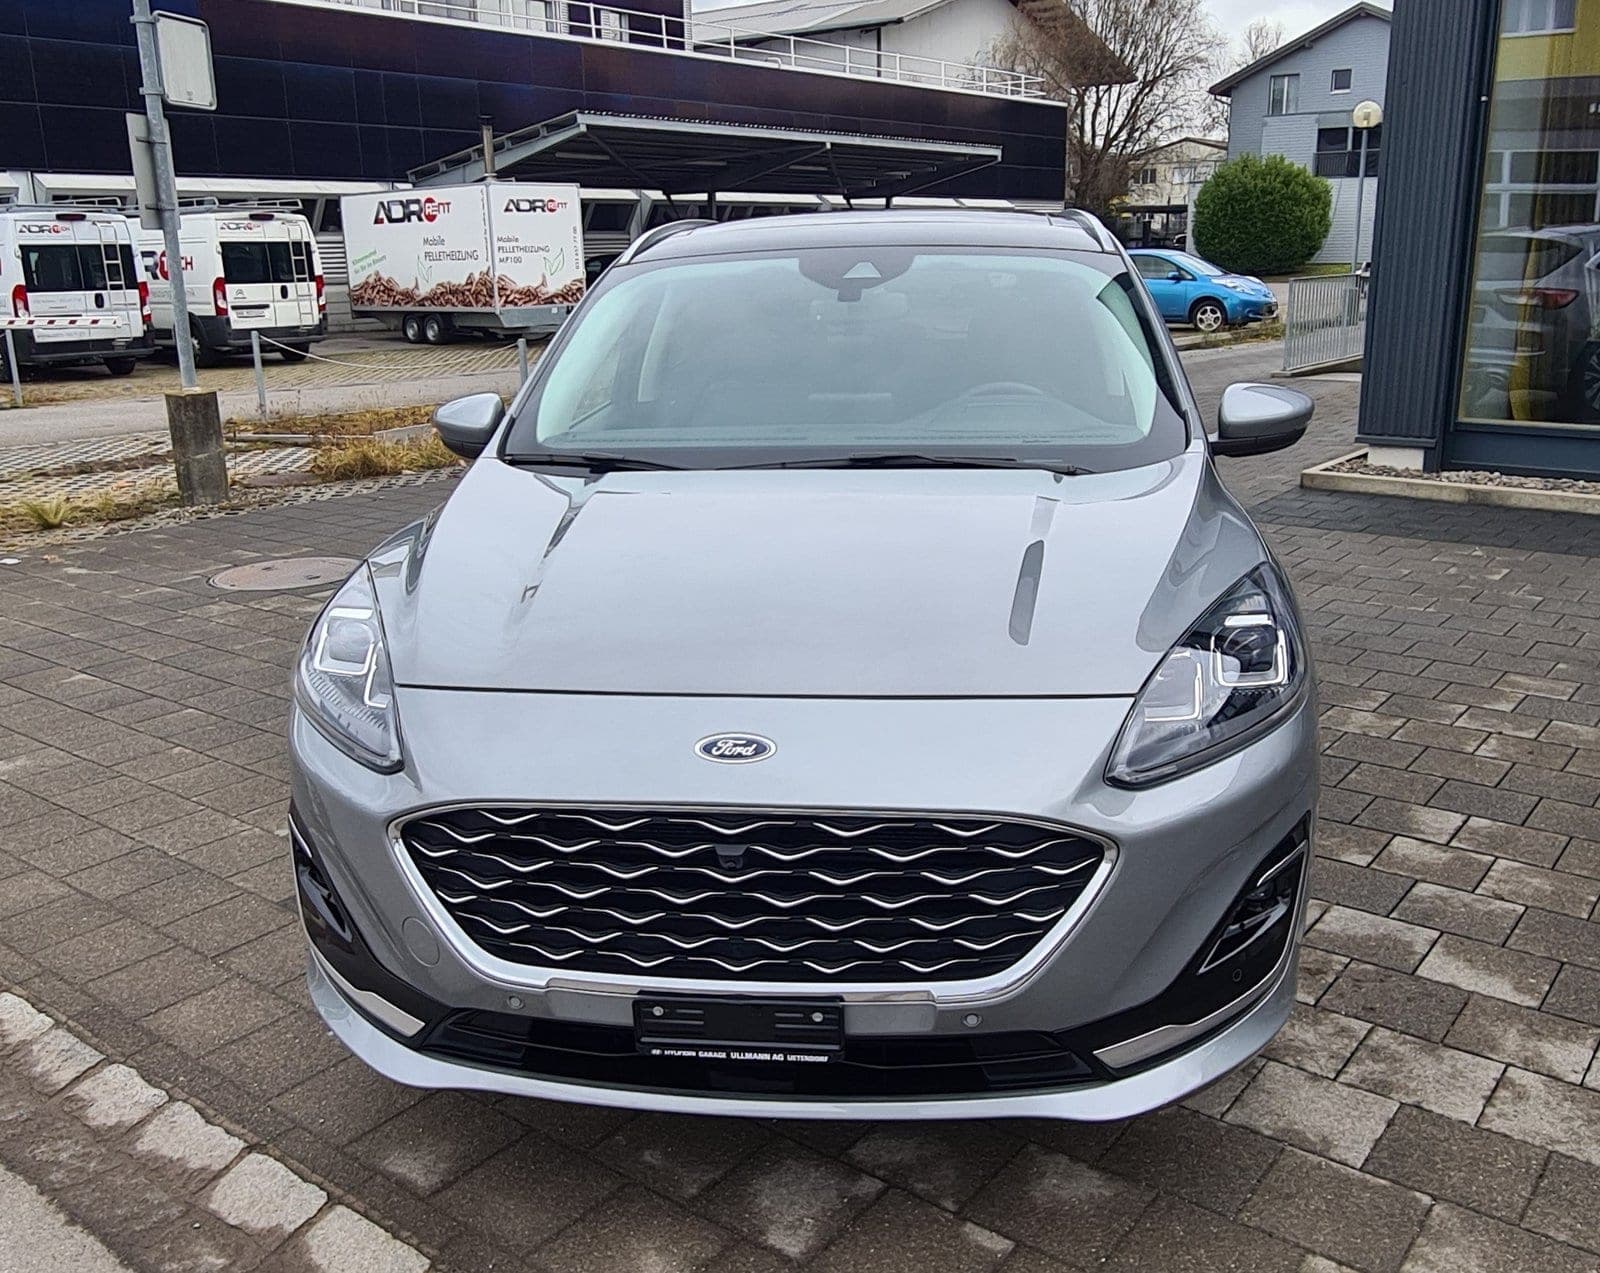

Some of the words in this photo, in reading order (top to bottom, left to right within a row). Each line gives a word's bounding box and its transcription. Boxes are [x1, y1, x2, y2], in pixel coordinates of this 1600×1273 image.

[423, 235, 445, 246] Mobile
[424, 249, 479, 262] PELLETHEIZUNG
[711, 739, 757, 756] Ford
[730, 1051, 771, 1061] ULLMANN
[772, 1053, 784, 1062] AG
